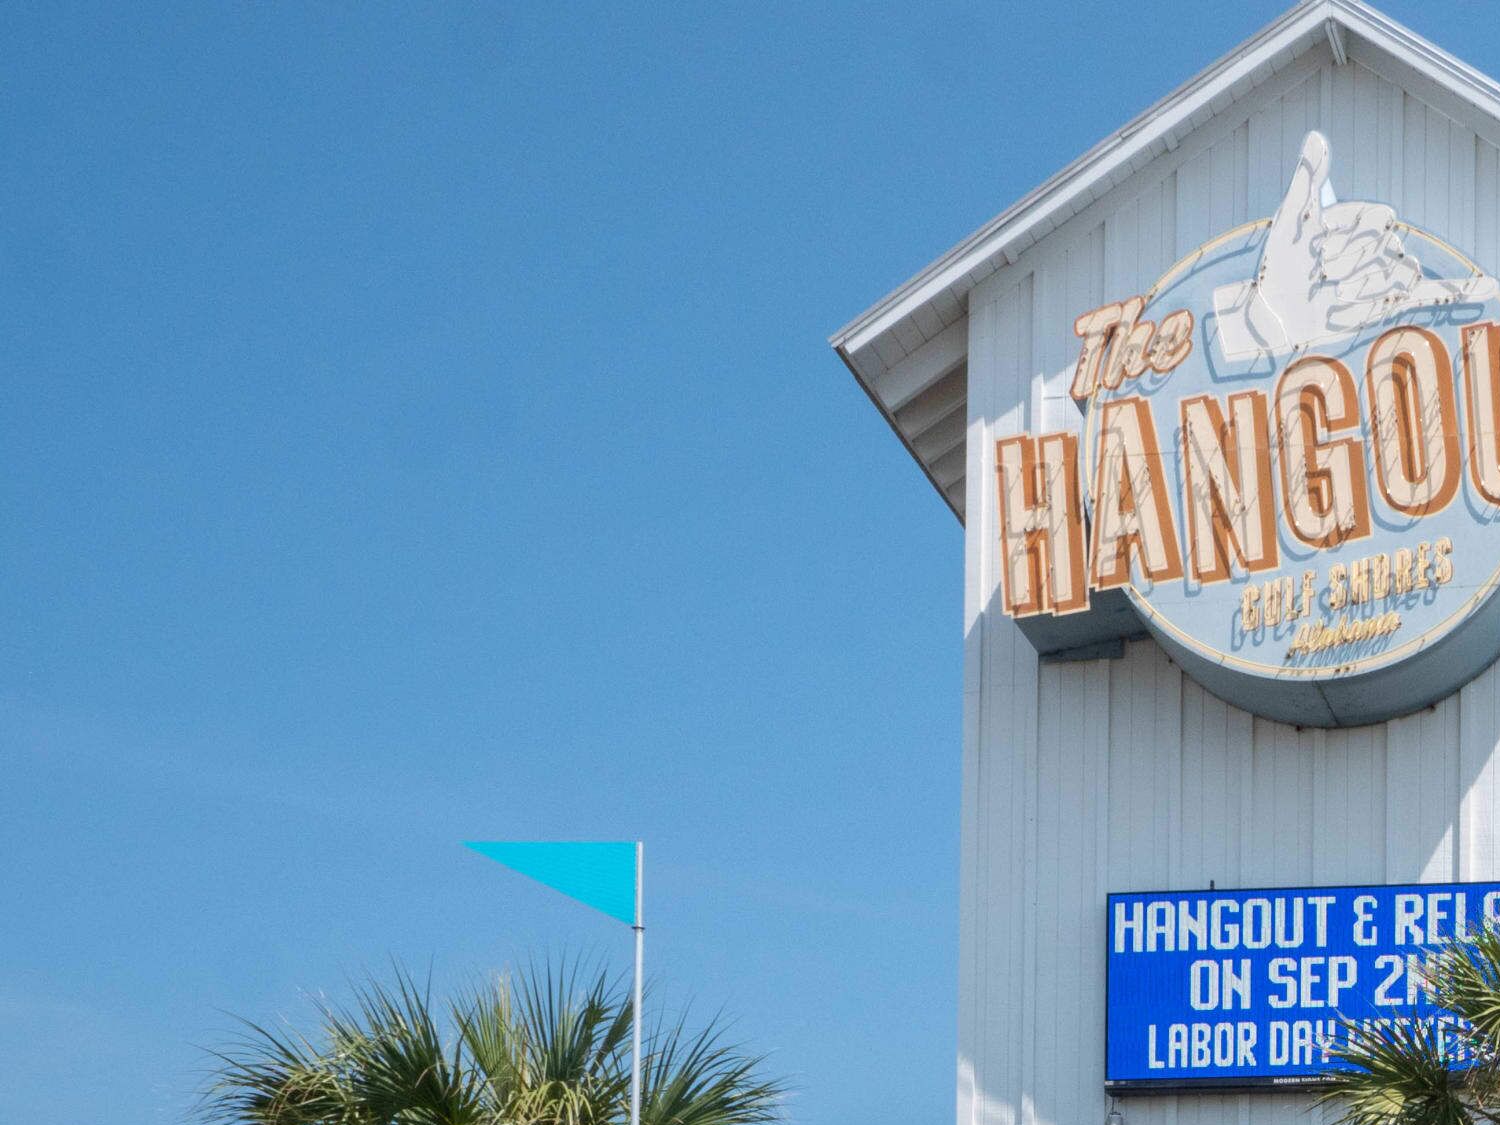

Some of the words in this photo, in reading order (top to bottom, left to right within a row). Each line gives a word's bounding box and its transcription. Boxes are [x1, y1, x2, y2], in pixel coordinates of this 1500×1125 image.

[1070, 296, 1194, 400] The
[1241, 569, 1317, 631] GULF
[1328, 537, 1454, 610] SHORES
[1114, 895, 1336, 953] HANGOUT
[1352, 895, 1378, 946] &
[1190, 958, 1251, 1010] ON
[1268, 955, 1357, 1008] SEP
[1149, 1023, 1257, 1069] LABOR
[1270, 1018, 1336, 1067] DAY
